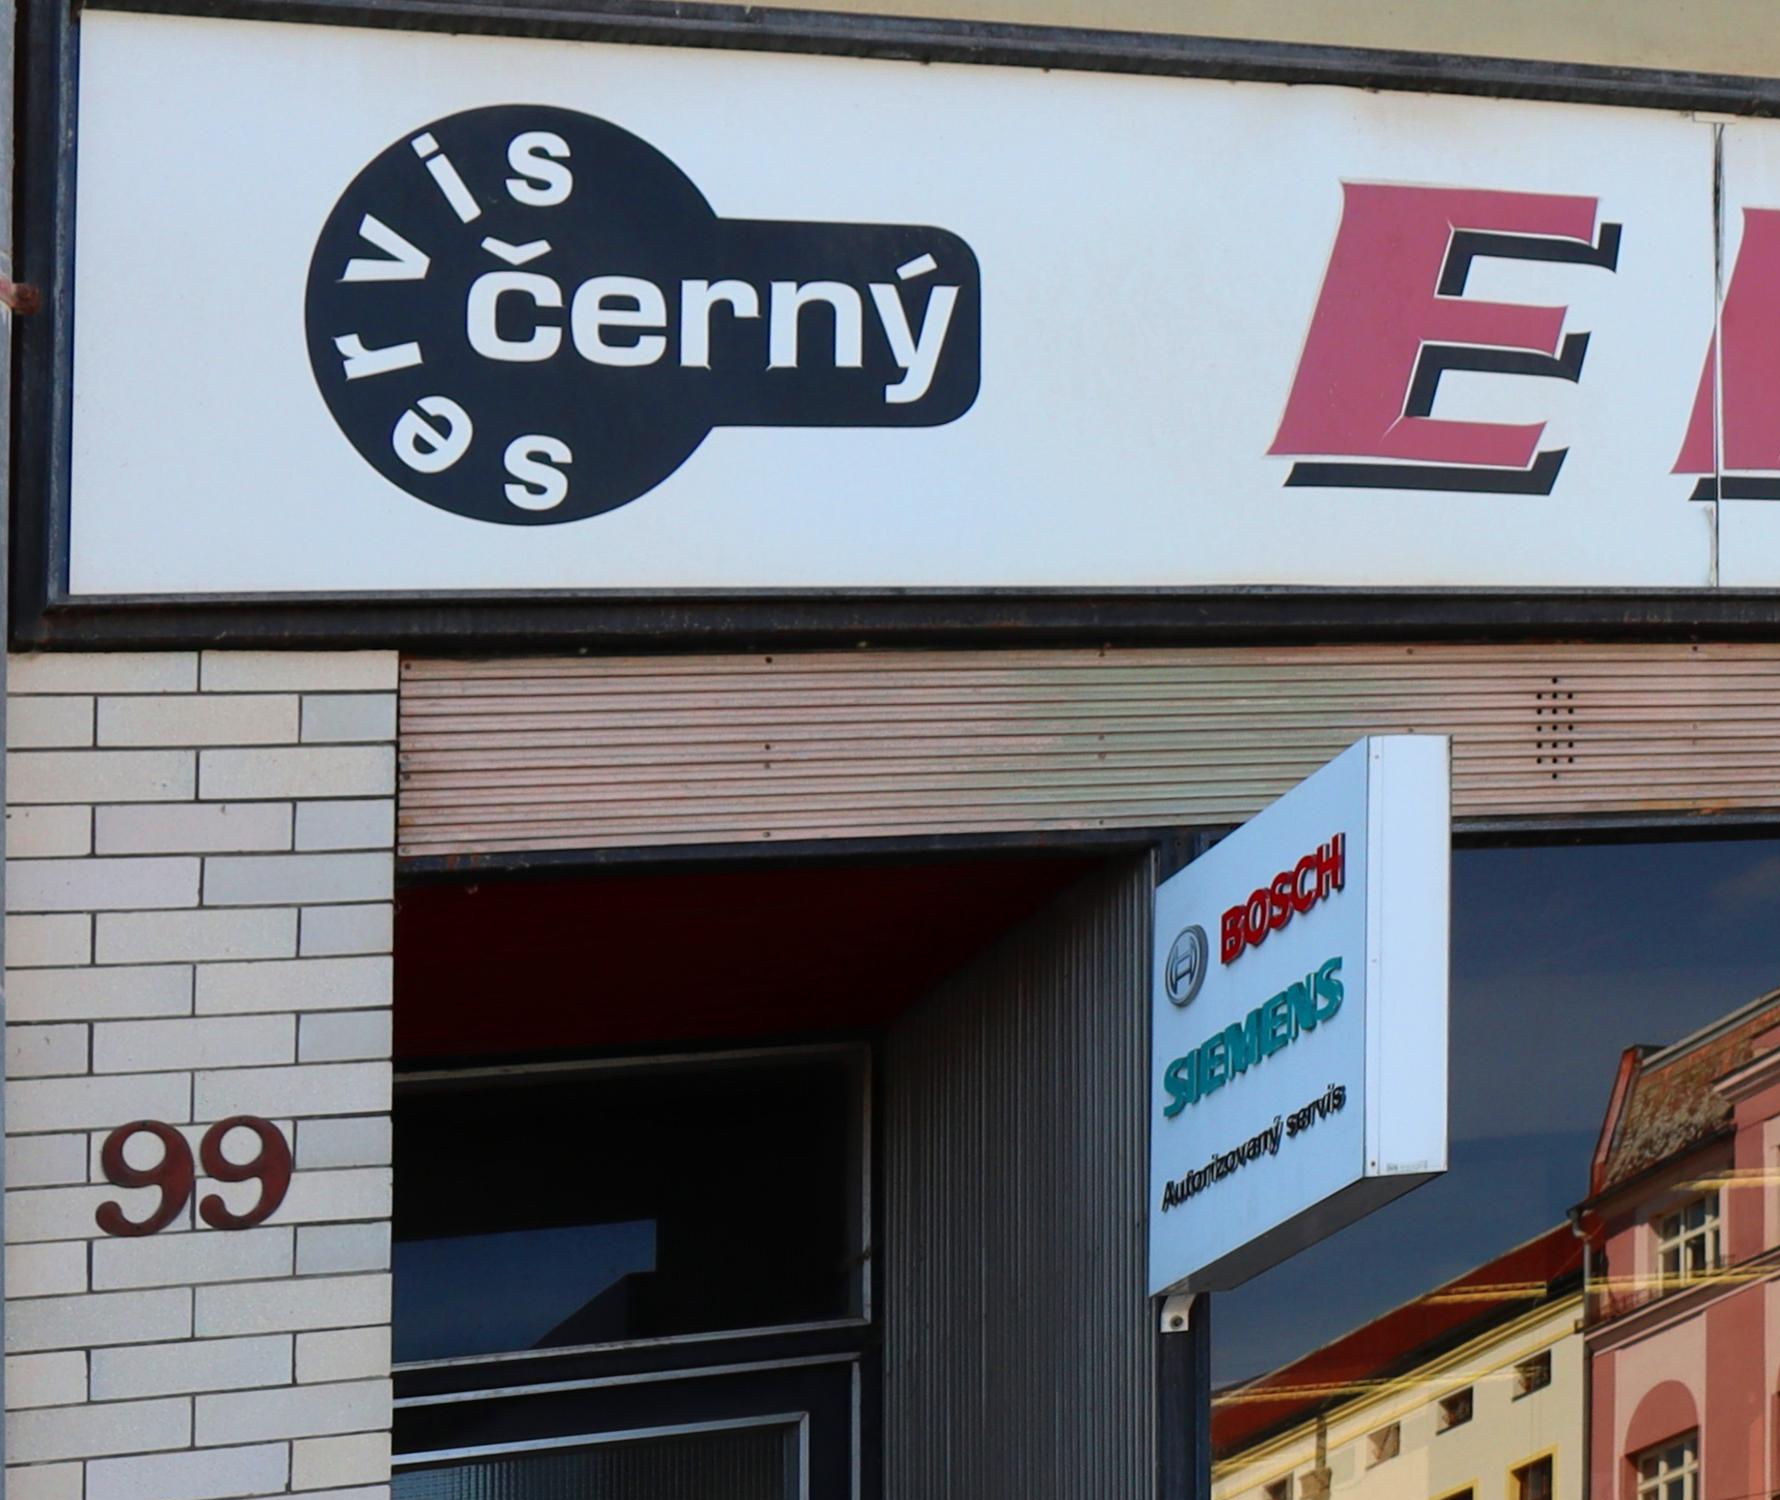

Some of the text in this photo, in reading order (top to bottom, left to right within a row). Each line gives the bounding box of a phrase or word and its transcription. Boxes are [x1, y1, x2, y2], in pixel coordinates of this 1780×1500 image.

[466, 235, 961, 404] černý
[1220, 832, 1346, 965] BOSCH
[1163, 956, 1344, 1118] SIEMENS
[95, 1115, 292, 1237] 99
[1161, 1084, 1346, 1212] Autorizovaný servis
